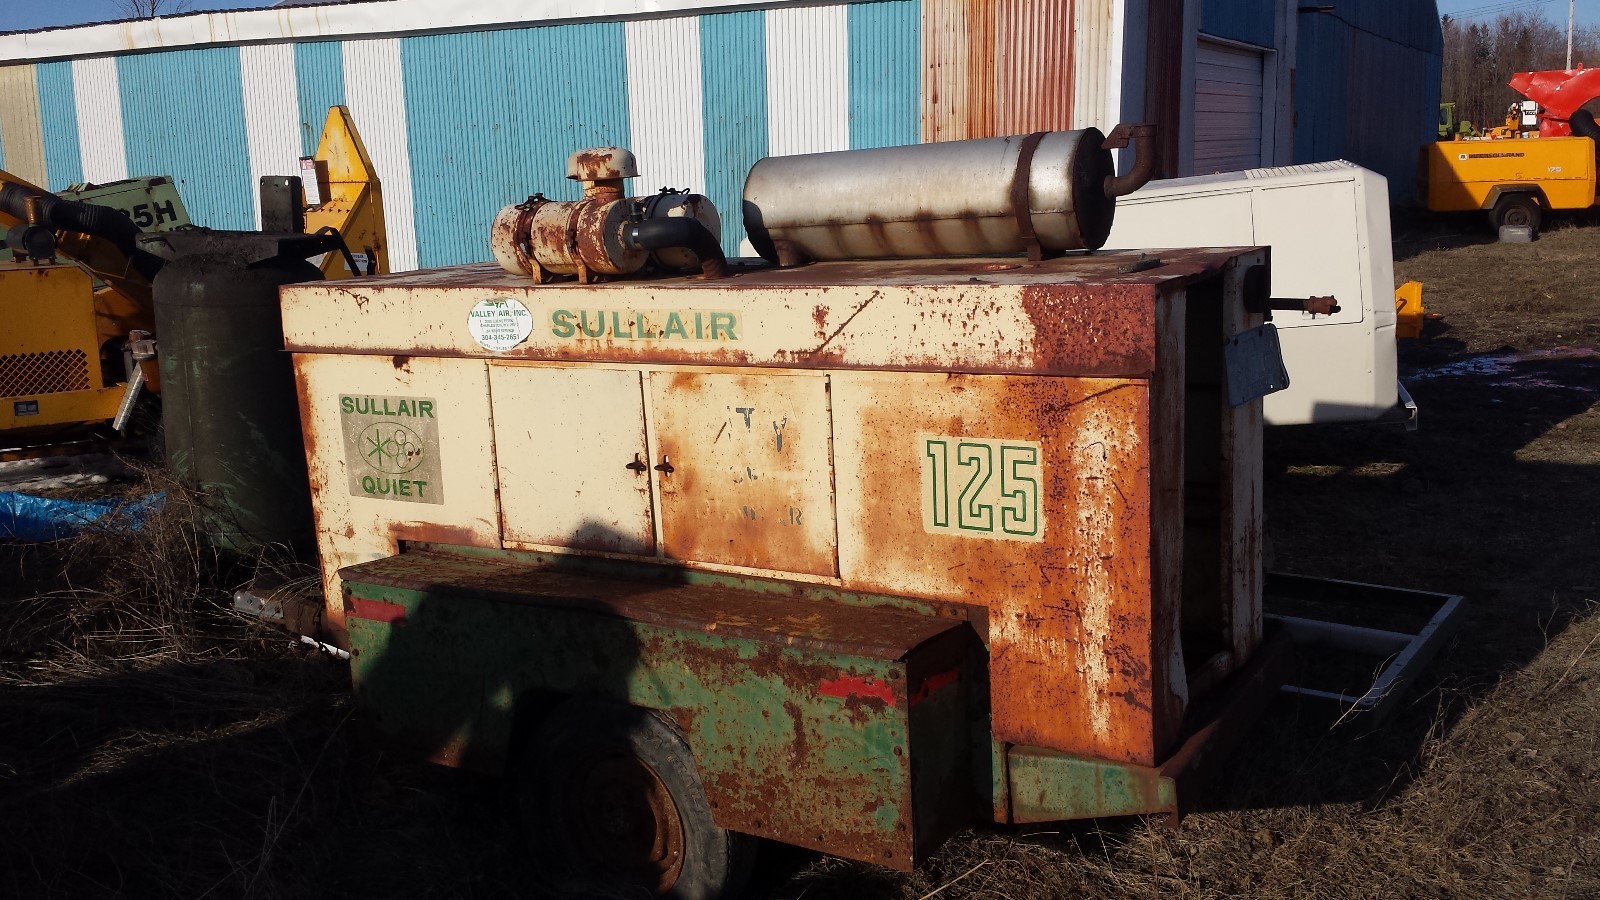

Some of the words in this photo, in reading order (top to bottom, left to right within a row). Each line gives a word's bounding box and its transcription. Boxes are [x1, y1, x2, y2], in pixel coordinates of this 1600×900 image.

[120, 200, 178, 228] 5H
[470, 310, 496, 318] VALLEY
[513, 309, 529, 317] INC.
[551, 309, 739, 341] SULLAIR
[341, 396, 434, 418] SULLAIR
[361, 475, 428, 498] QUIET
[926, 439, 1038, 537] 125
